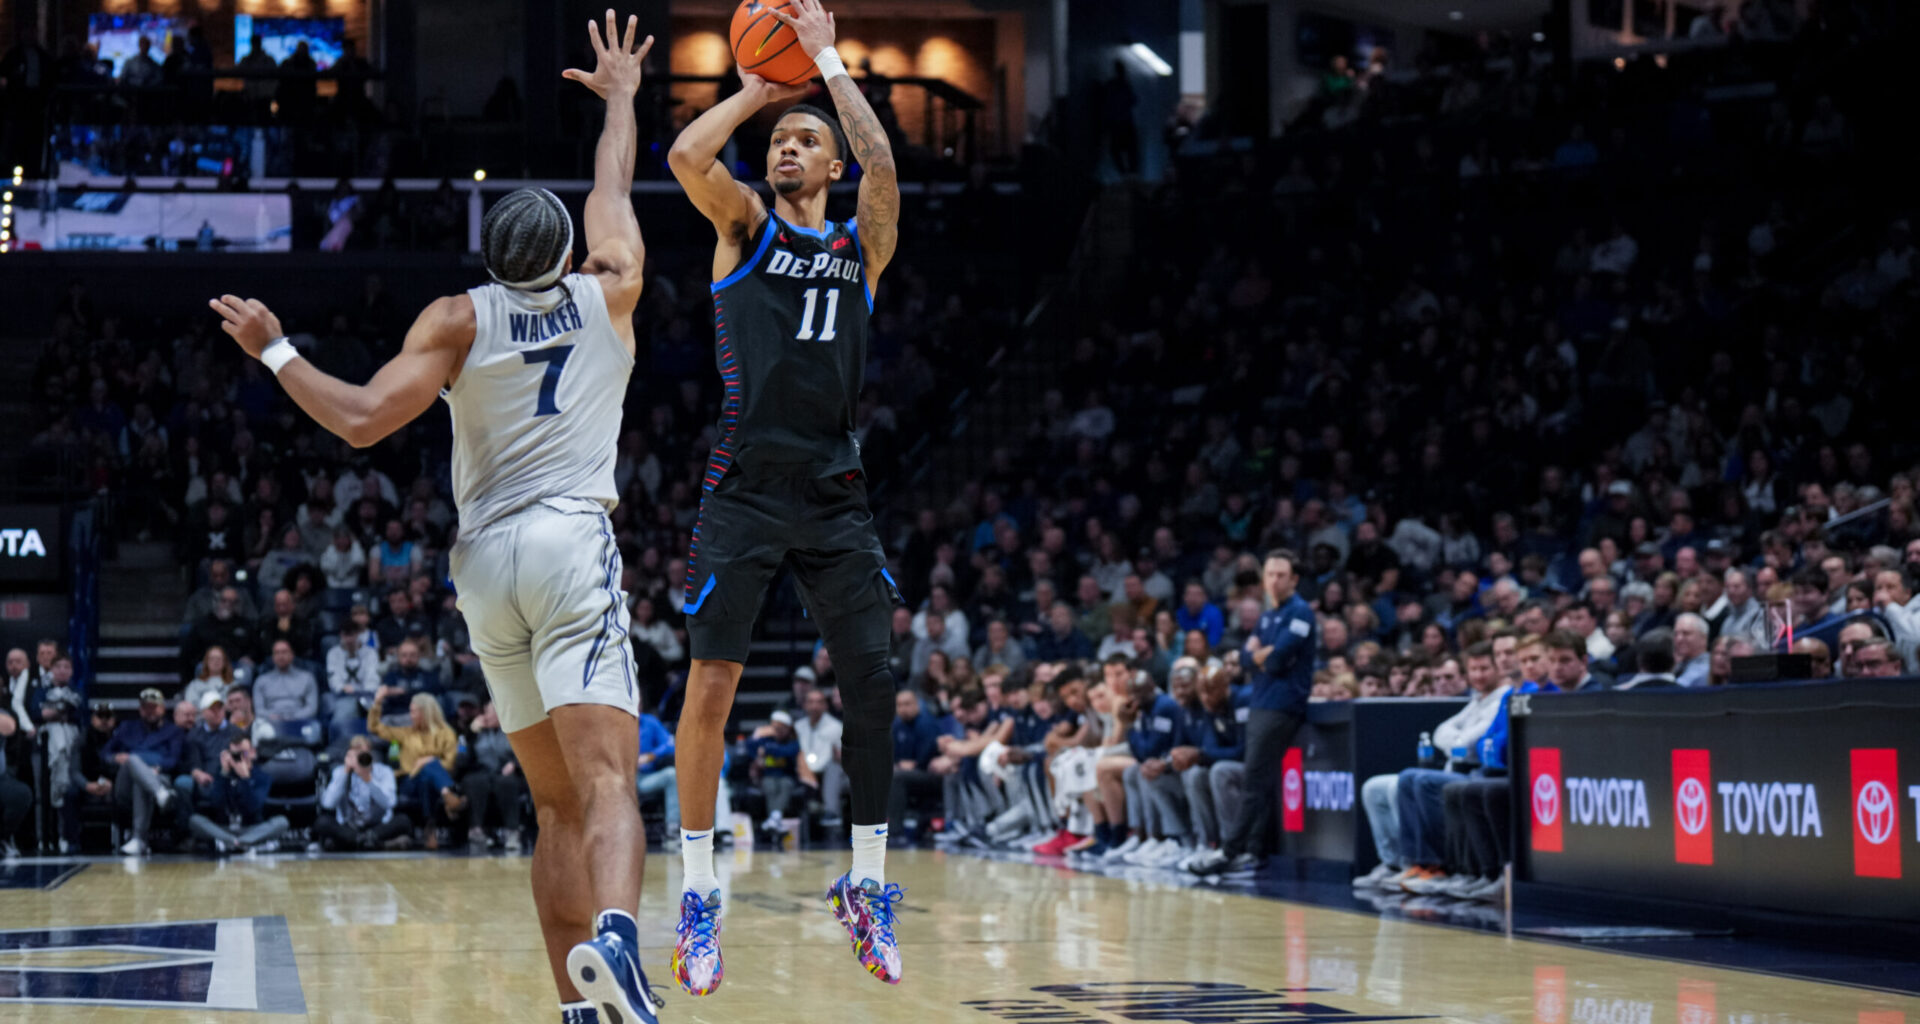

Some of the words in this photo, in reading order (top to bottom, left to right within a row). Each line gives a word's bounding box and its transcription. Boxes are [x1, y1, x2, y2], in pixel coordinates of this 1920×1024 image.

[765, 249, 861, 283] DEPAUL
[509, 301, 583, 343] WALKER
[795, 288, 840, 341] 11
[520, 344, 576, 417] 7
[0, 528, 46, 557] TA
[1566, 777, 1650, 828] TOYOTA
[1718, 782, 1823, 837] TOYOTA
